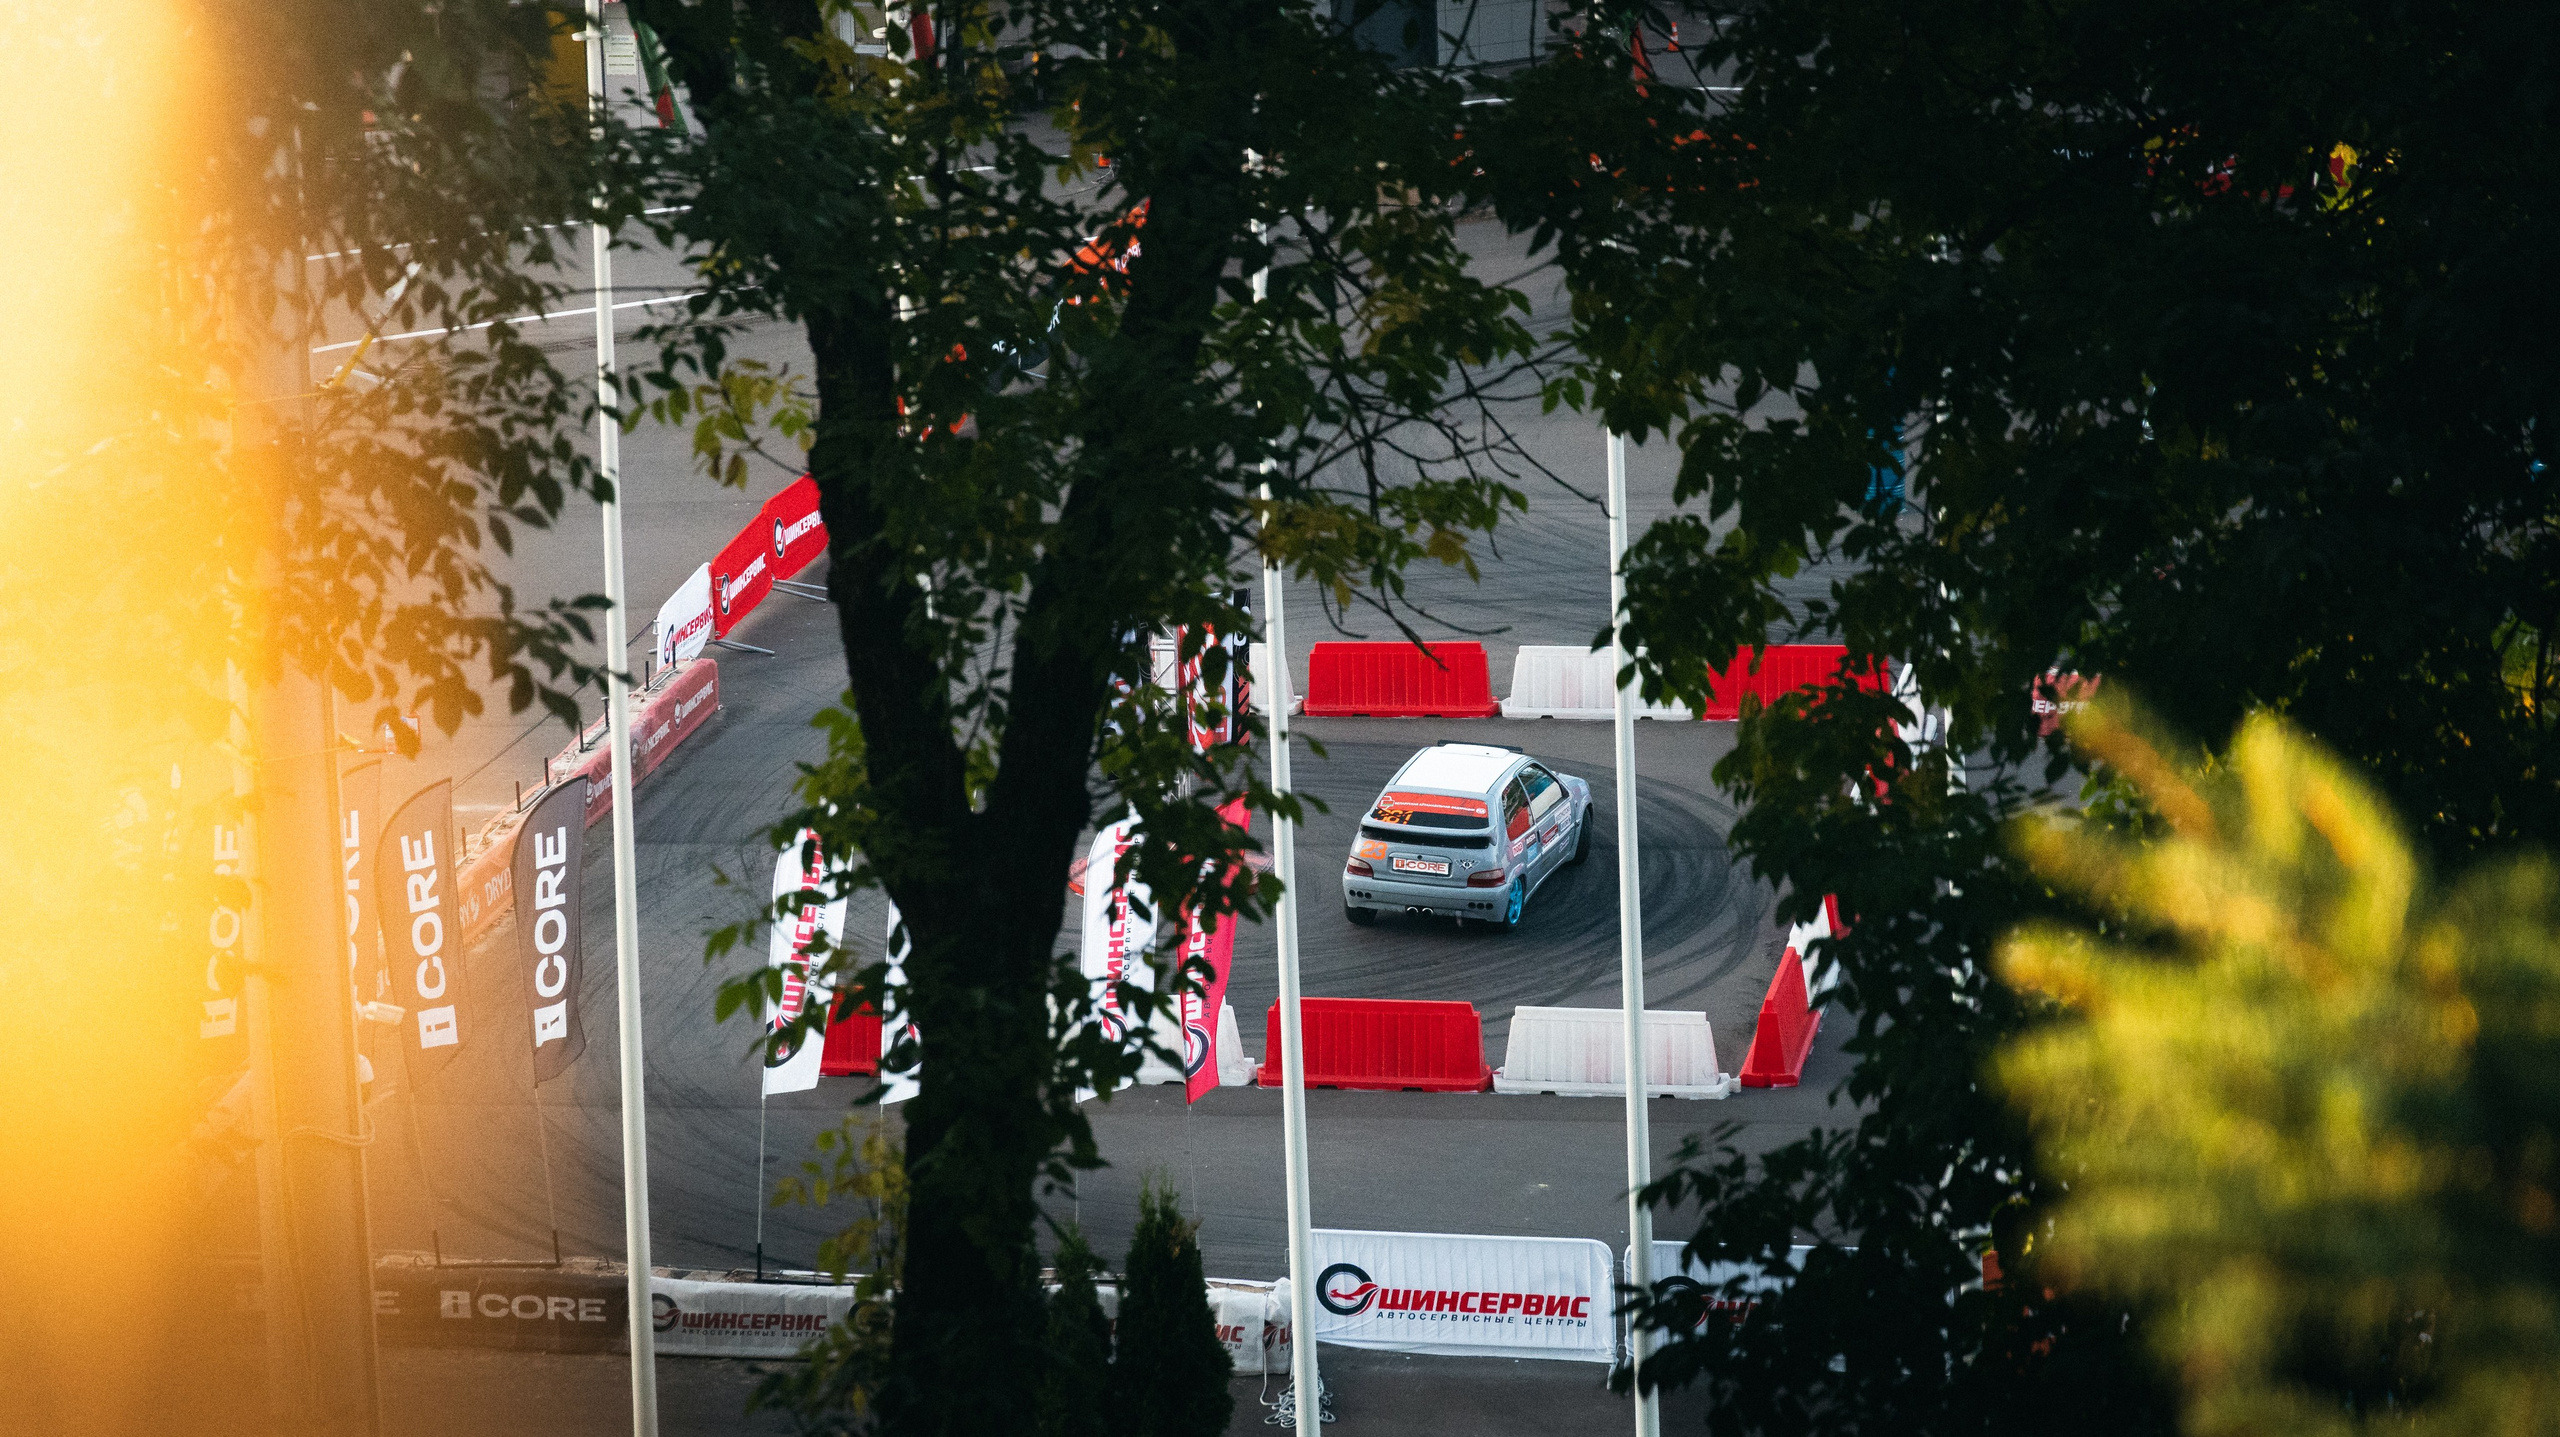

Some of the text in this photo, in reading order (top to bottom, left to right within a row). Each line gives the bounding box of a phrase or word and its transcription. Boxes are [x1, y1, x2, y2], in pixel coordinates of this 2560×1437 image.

[784, 509, 823, 546] ШИНСЕРВИ
[1360, 840, 1387, 860] 23
[1378, 1288, 1591, 1319] ШИНСЕРВИС
[681, 1312, 827, 1332] ШИНСЕРВИС
[1376, 1311, 1588, 1328] АВТОСЕРВИСНЫЕ ЦЕНТРЫ
[681, 1328, 775, 1338] АВТОСЕРВИСНЫЕ
